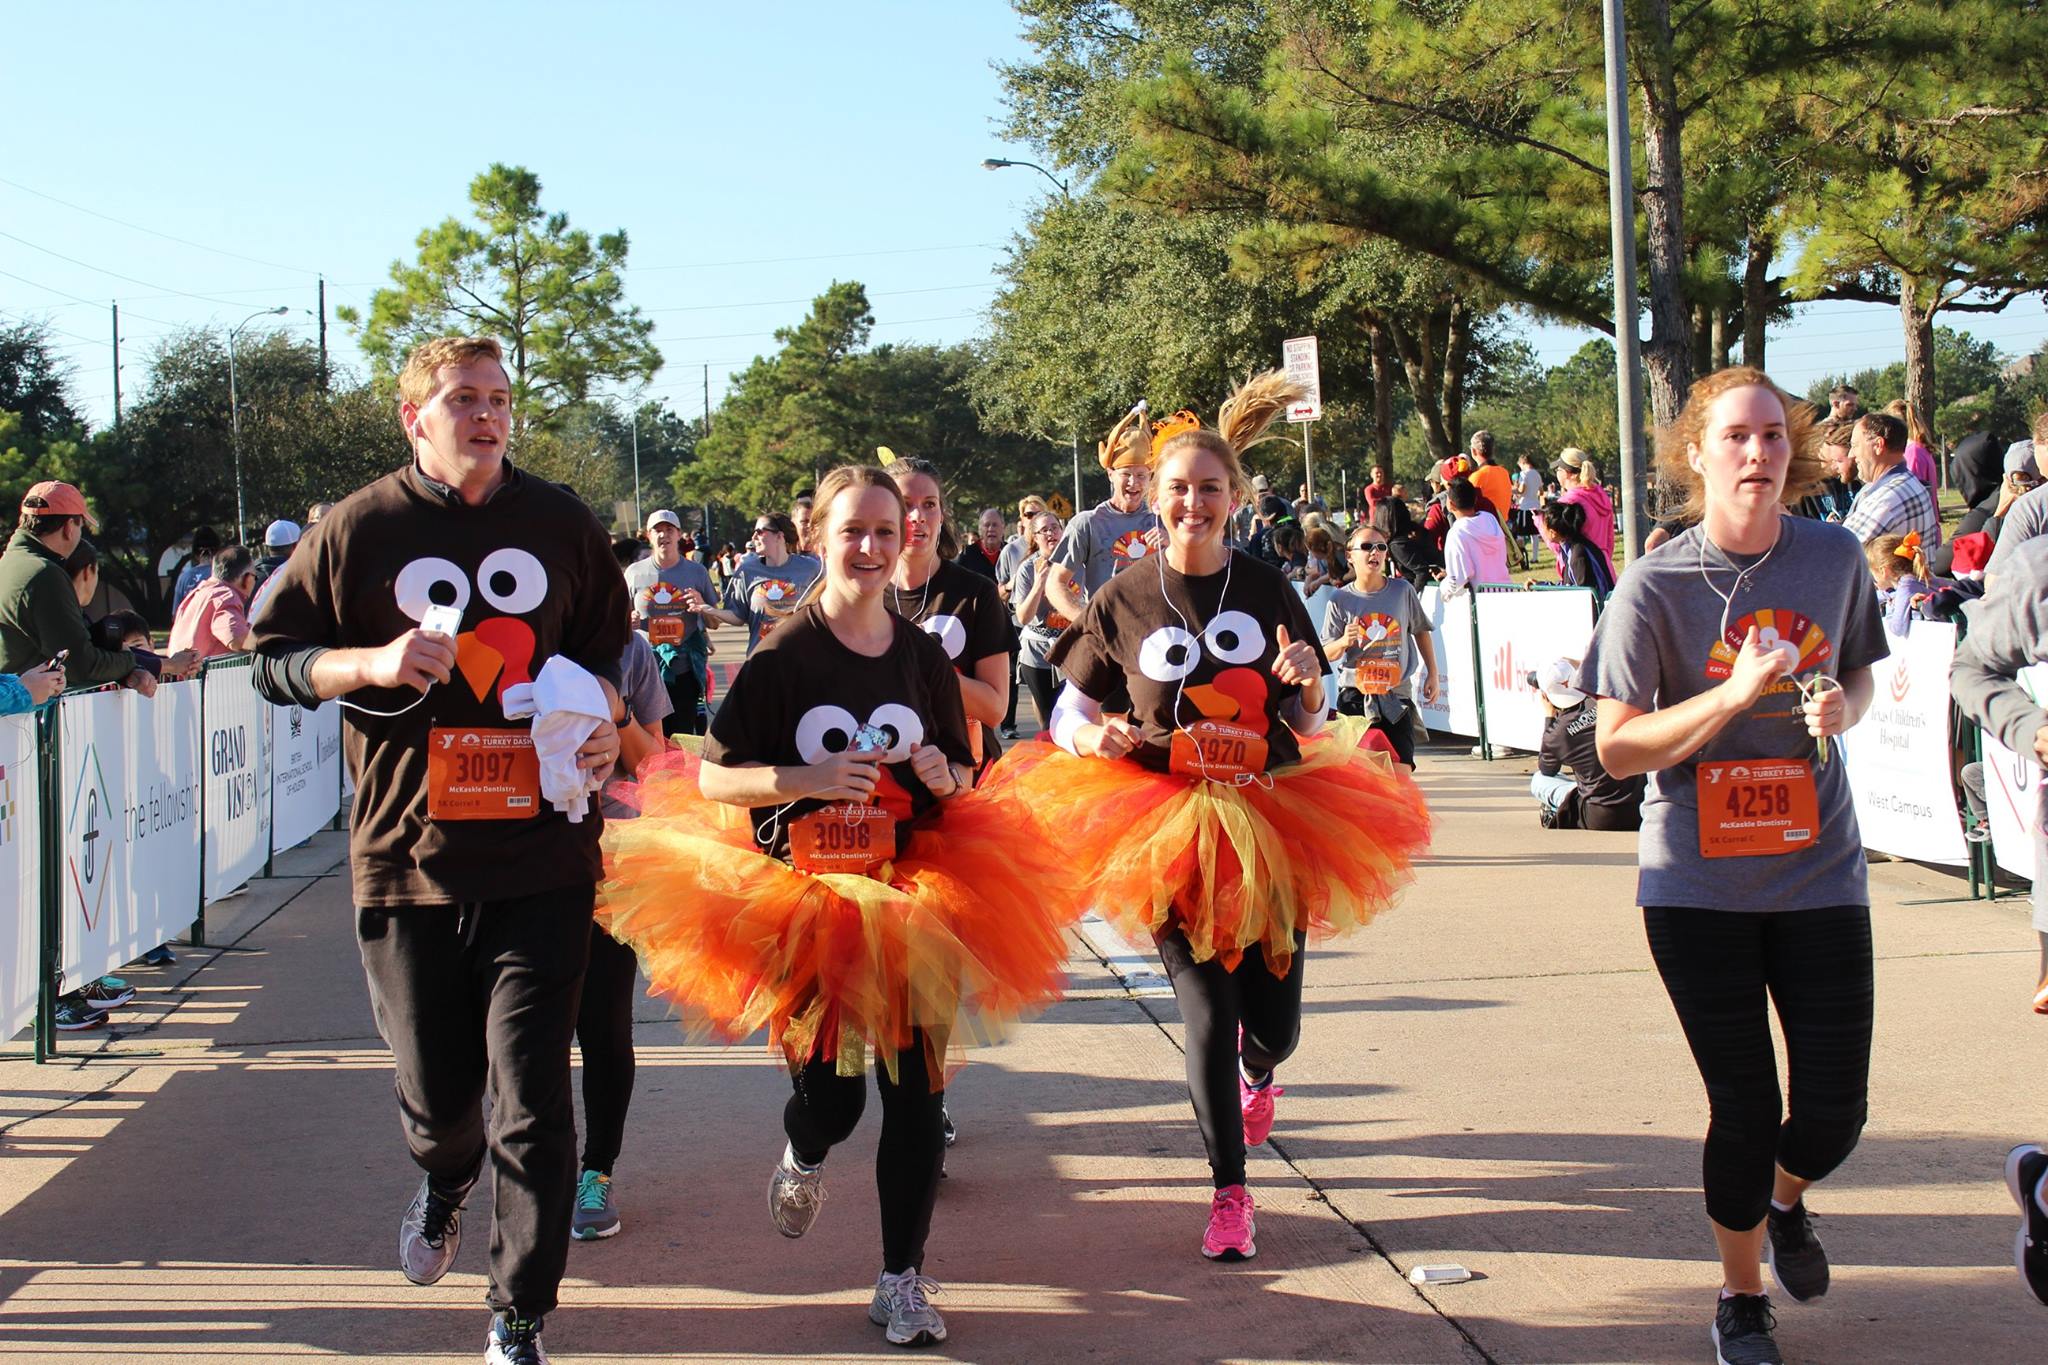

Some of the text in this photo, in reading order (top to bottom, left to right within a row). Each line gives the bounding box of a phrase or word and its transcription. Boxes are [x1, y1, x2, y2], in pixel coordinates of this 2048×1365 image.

[212, 725, 246, 776] GRAND
[482, 738, 511, 746] TURKEY
[513, 738, 532, 746] DASH
[1880, 728, 1909, 751] Hospital
[456, 752, 516, 784] 3097
[1752, 769, 1783, 778] TURKEY
[483, 785, 516, 794] Dentistry
[1726, 784, 1790, 818] 4258
[124, 772, 200, 843] the fellowship
[1868, 791, 1933, 820] West Campus
[1757, 819, 1792, 827] Dentistry
[815, 823, 871, 850] 3098
[841, 852, 872, 860] Dentistry
